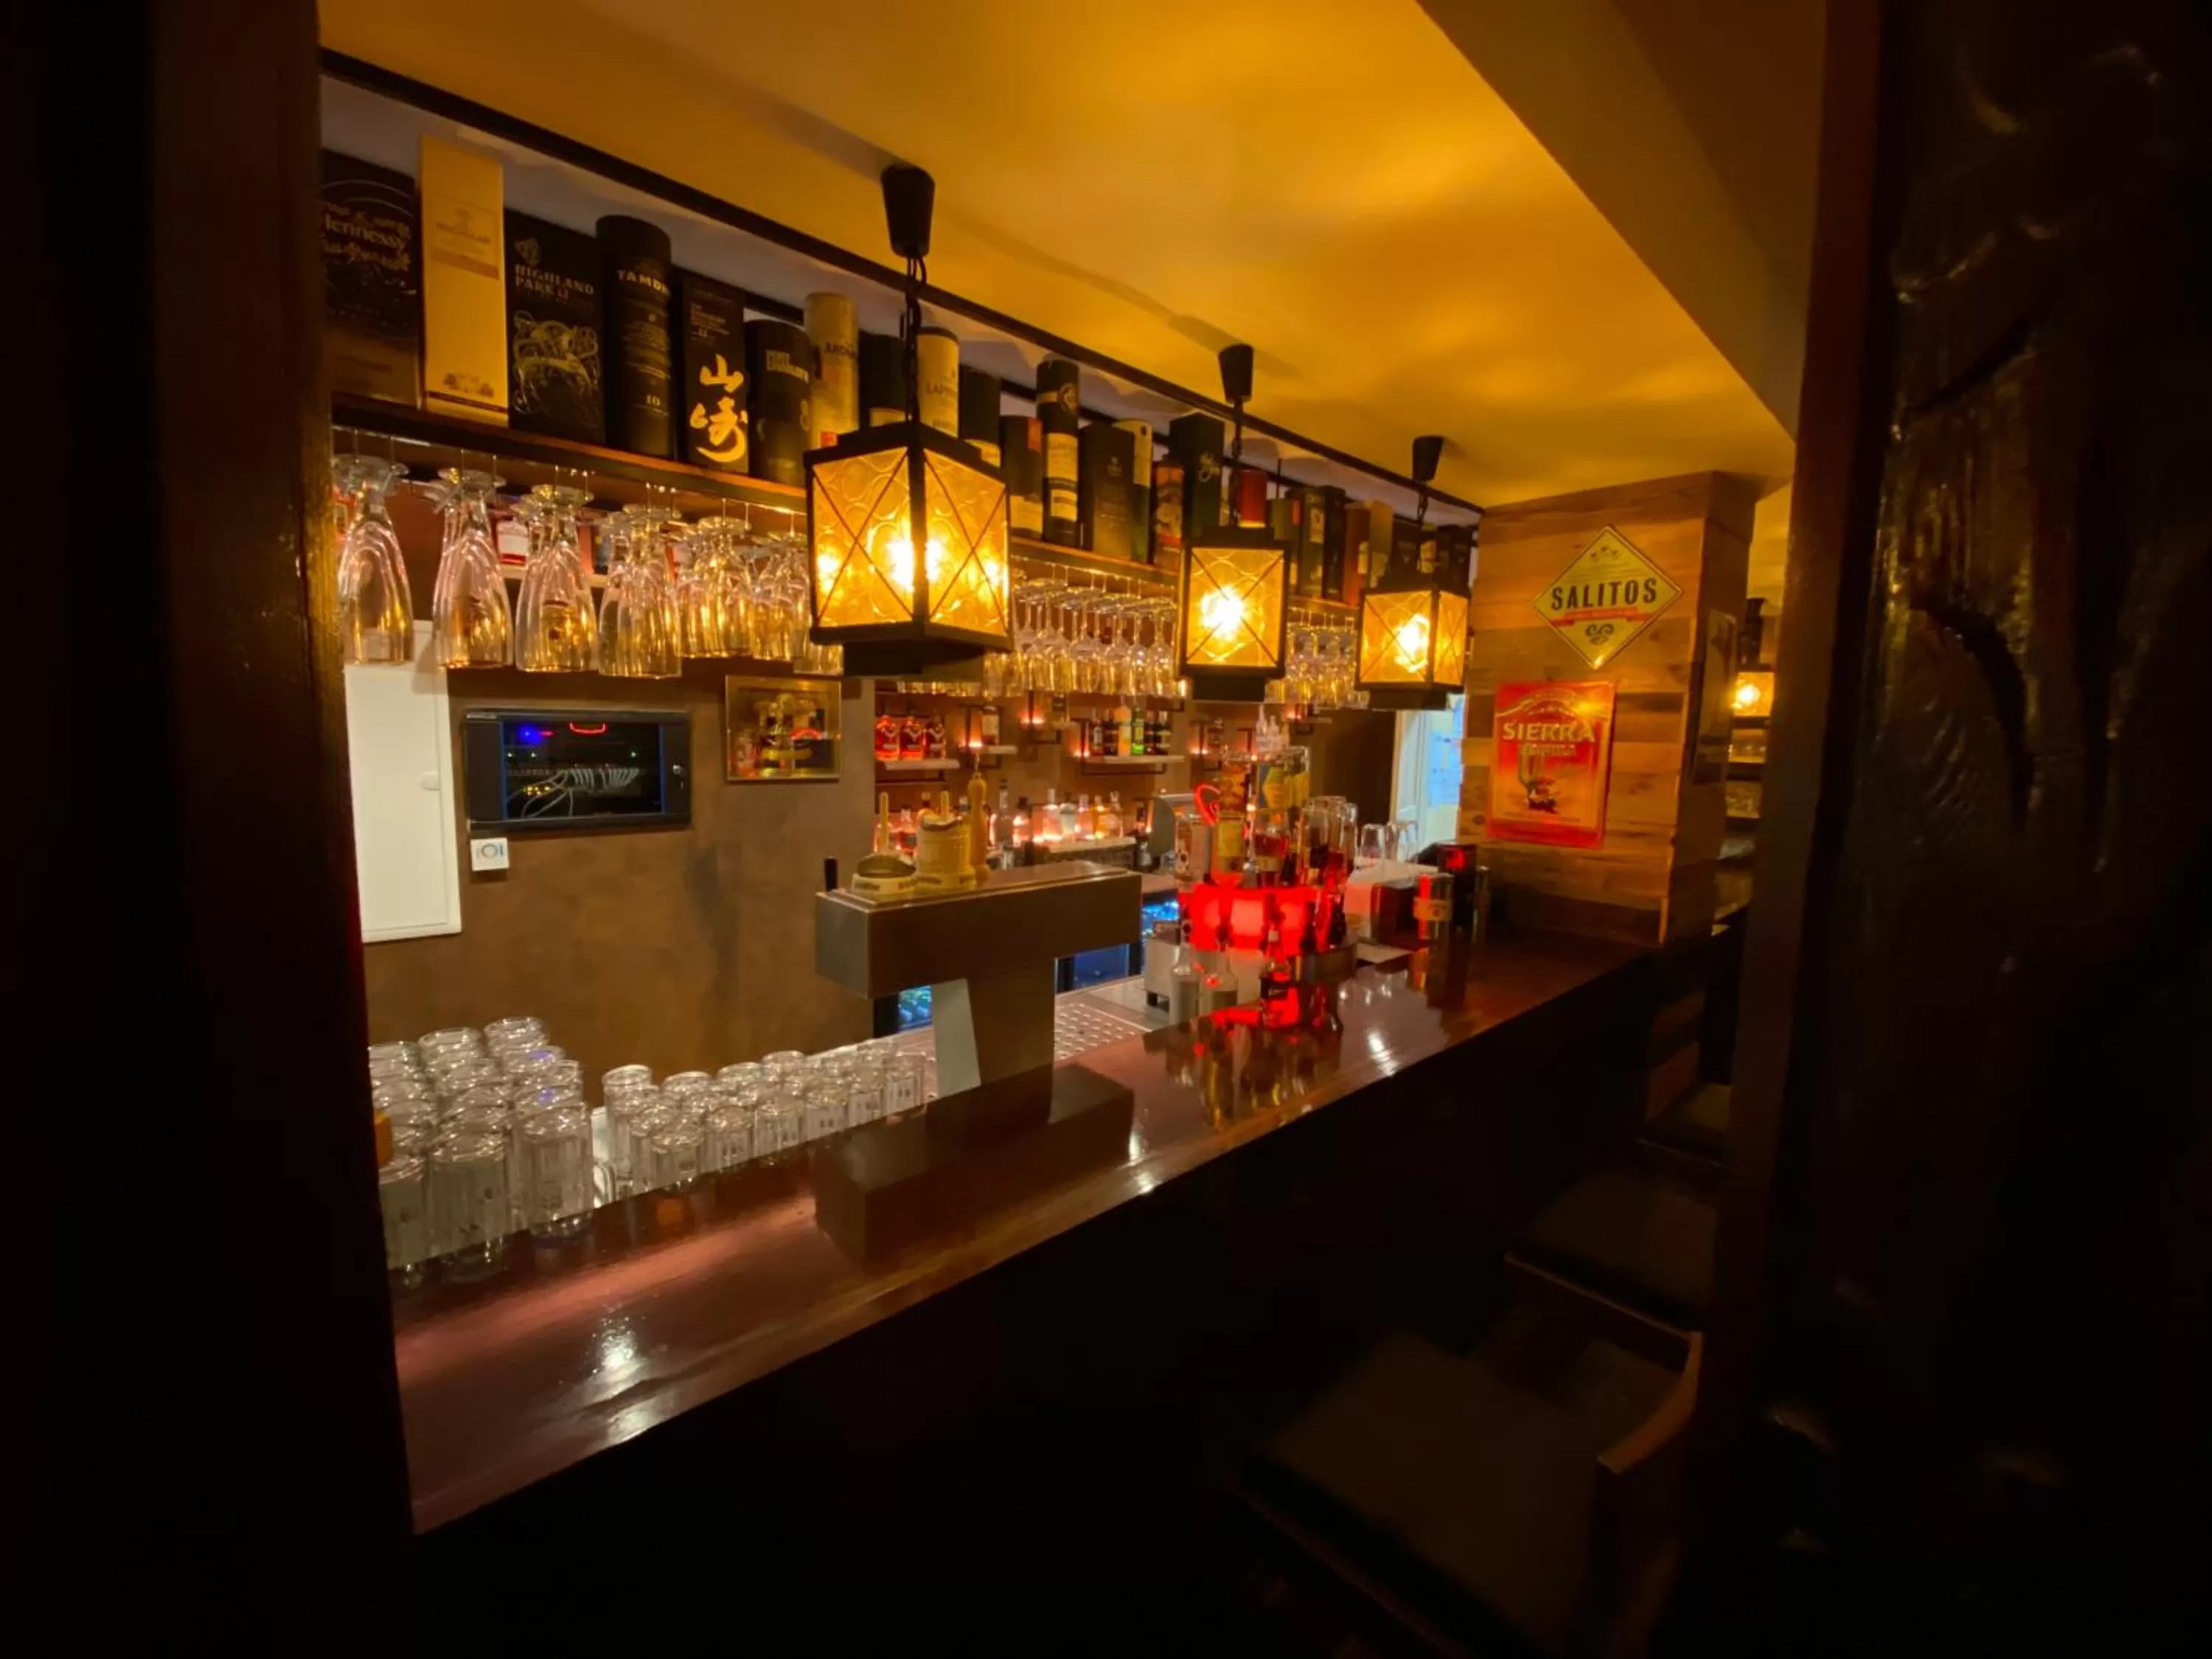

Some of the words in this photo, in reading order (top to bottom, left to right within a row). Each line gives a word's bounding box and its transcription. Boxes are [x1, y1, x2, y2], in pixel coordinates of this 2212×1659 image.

[515, 263, 594, 296] HIGHLAND
[515, 276, 554, 296] PARK
[1551, 577, 1658, 612] SALITOS
[1502, 720, 1596, 744] SIERRA
